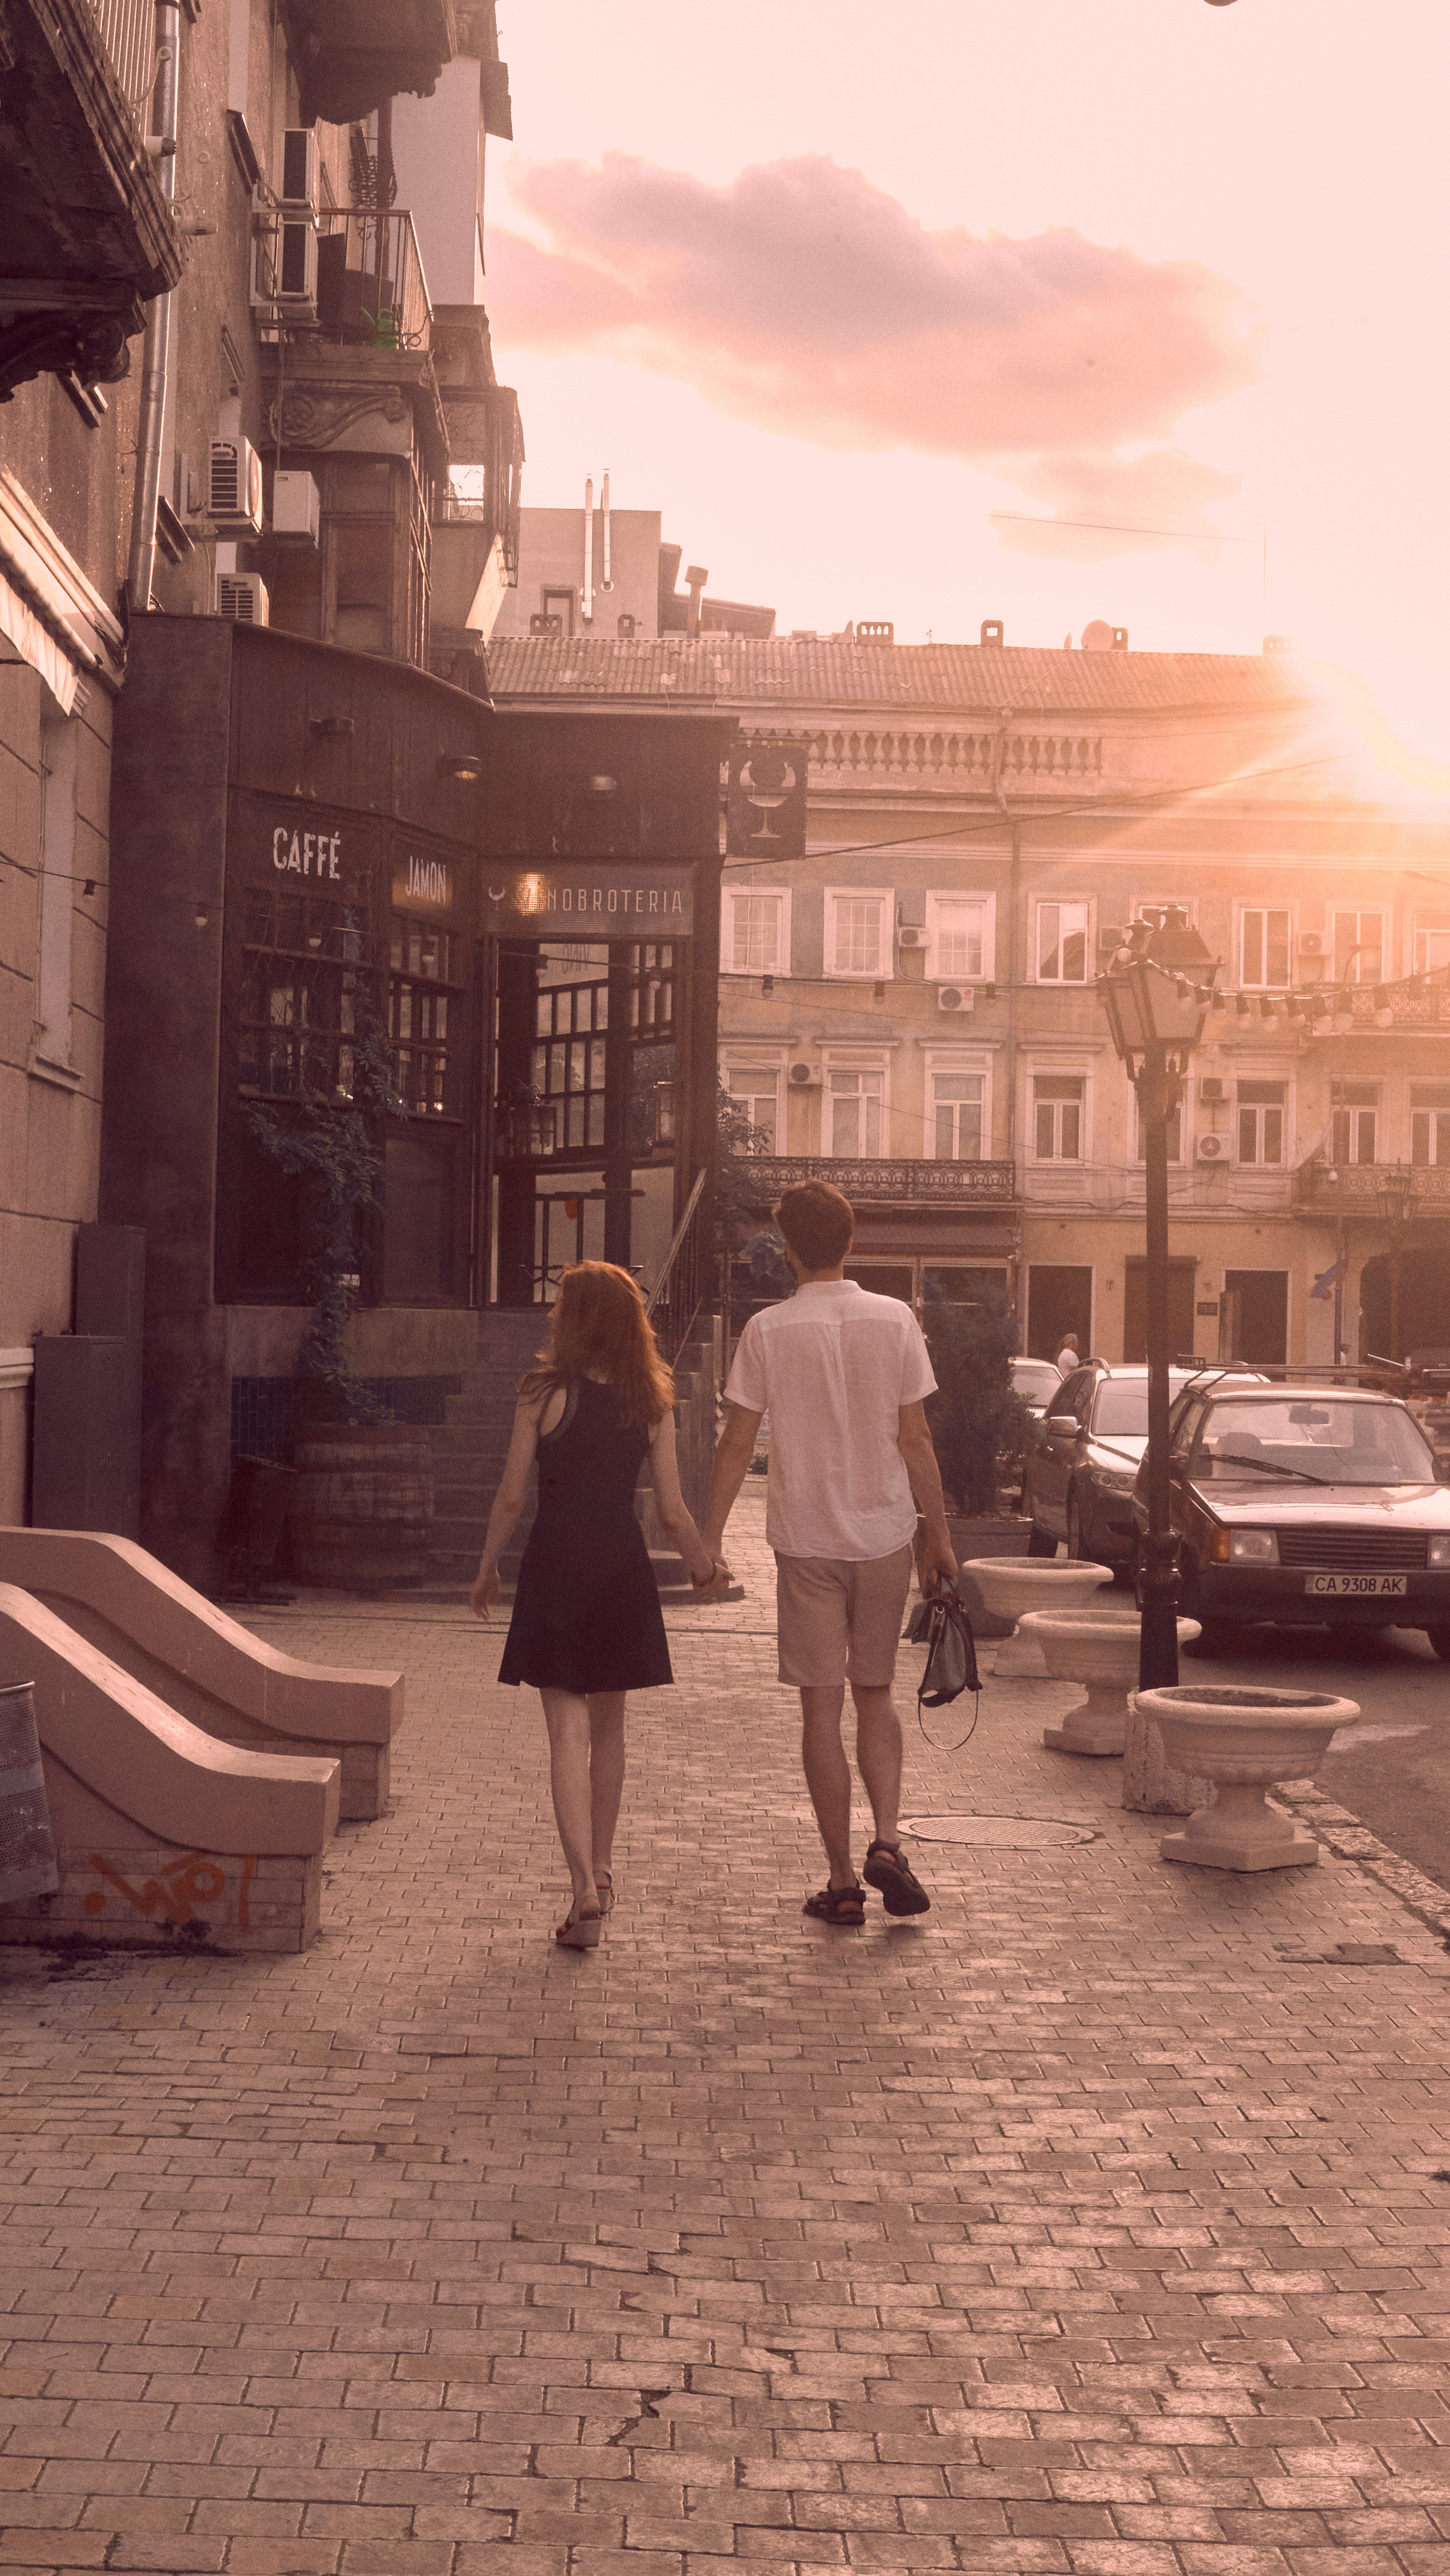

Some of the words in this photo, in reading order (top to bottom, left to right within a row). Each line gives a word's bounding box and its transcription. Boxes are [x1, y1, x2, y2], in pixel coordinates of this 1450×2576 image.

[273, 827, 341, 880] CAFFÉ
[405, 855, 446, 904] JAMON
[521, 887, 682, 913] VINOBROTERIA
[1315, 1577, 1337, 1592] CA
[1342, 1577, 1377, 1592] 9308
[1381, 1578, 1403, 1592] AK
